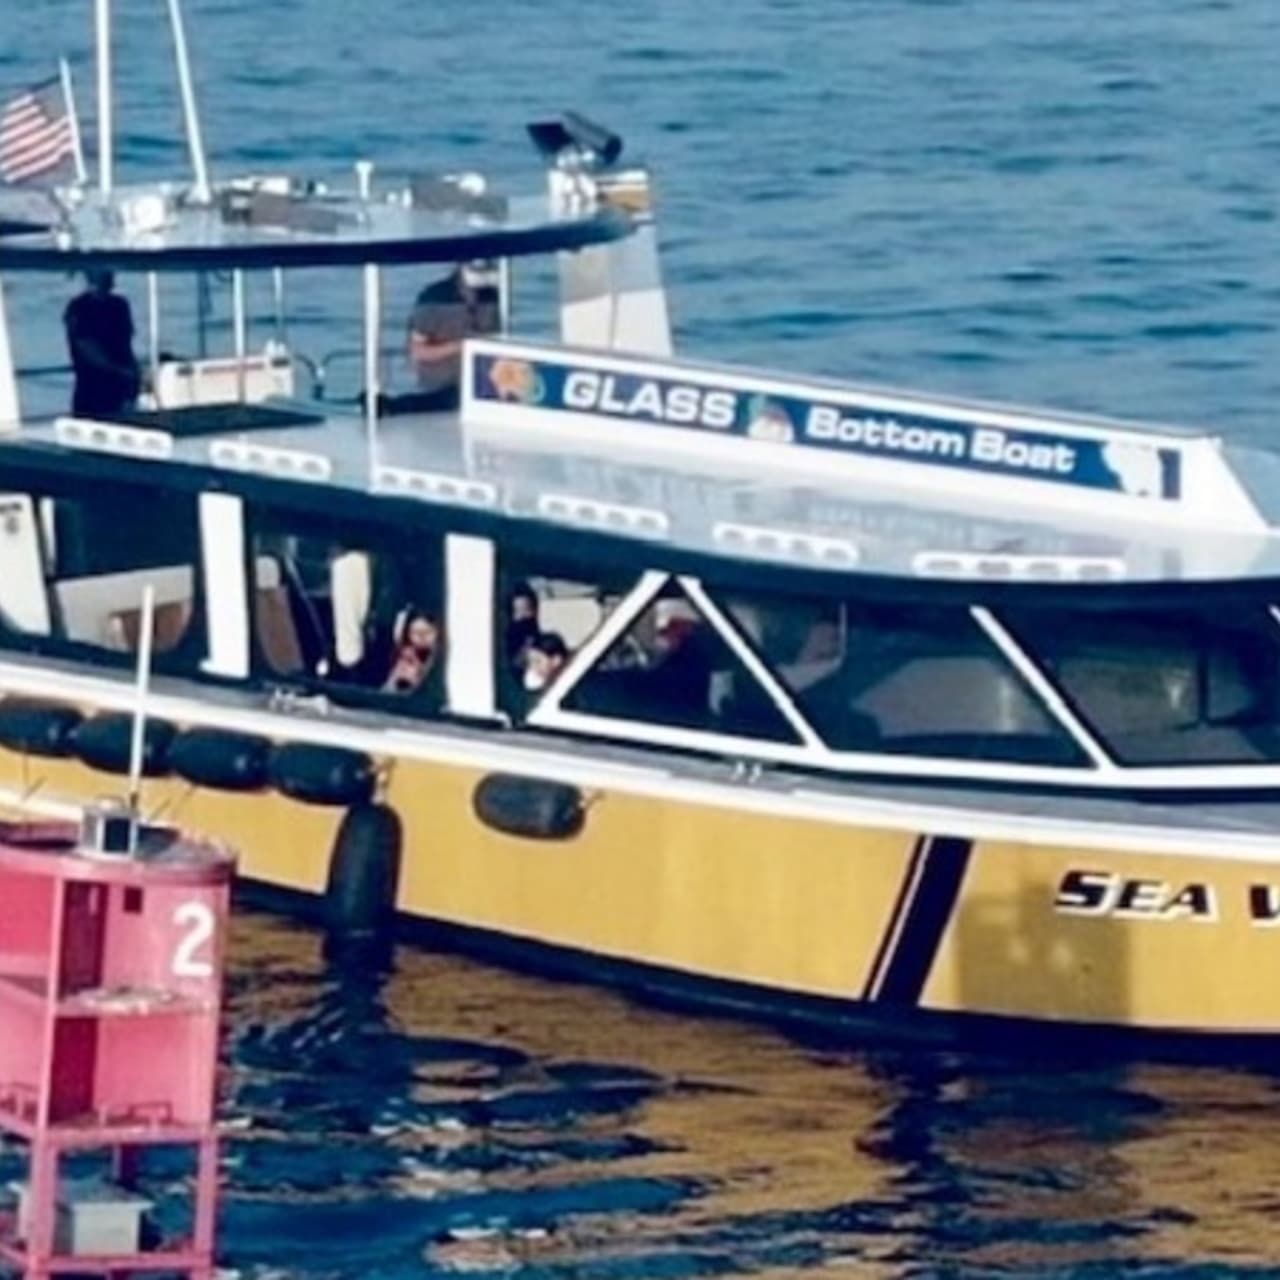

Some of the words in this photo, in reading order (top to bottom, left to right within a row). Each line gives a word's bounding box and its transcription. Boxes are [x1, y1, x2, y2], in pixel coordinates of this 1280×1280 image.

[562, 373, 736, 428] GLASS
[805, 406, 965, 459] Bottom
[970, 428, 1076, 474] Boat
[1054, 869, 1218, 921] SEA
[171, 902, 214, 976] 2
